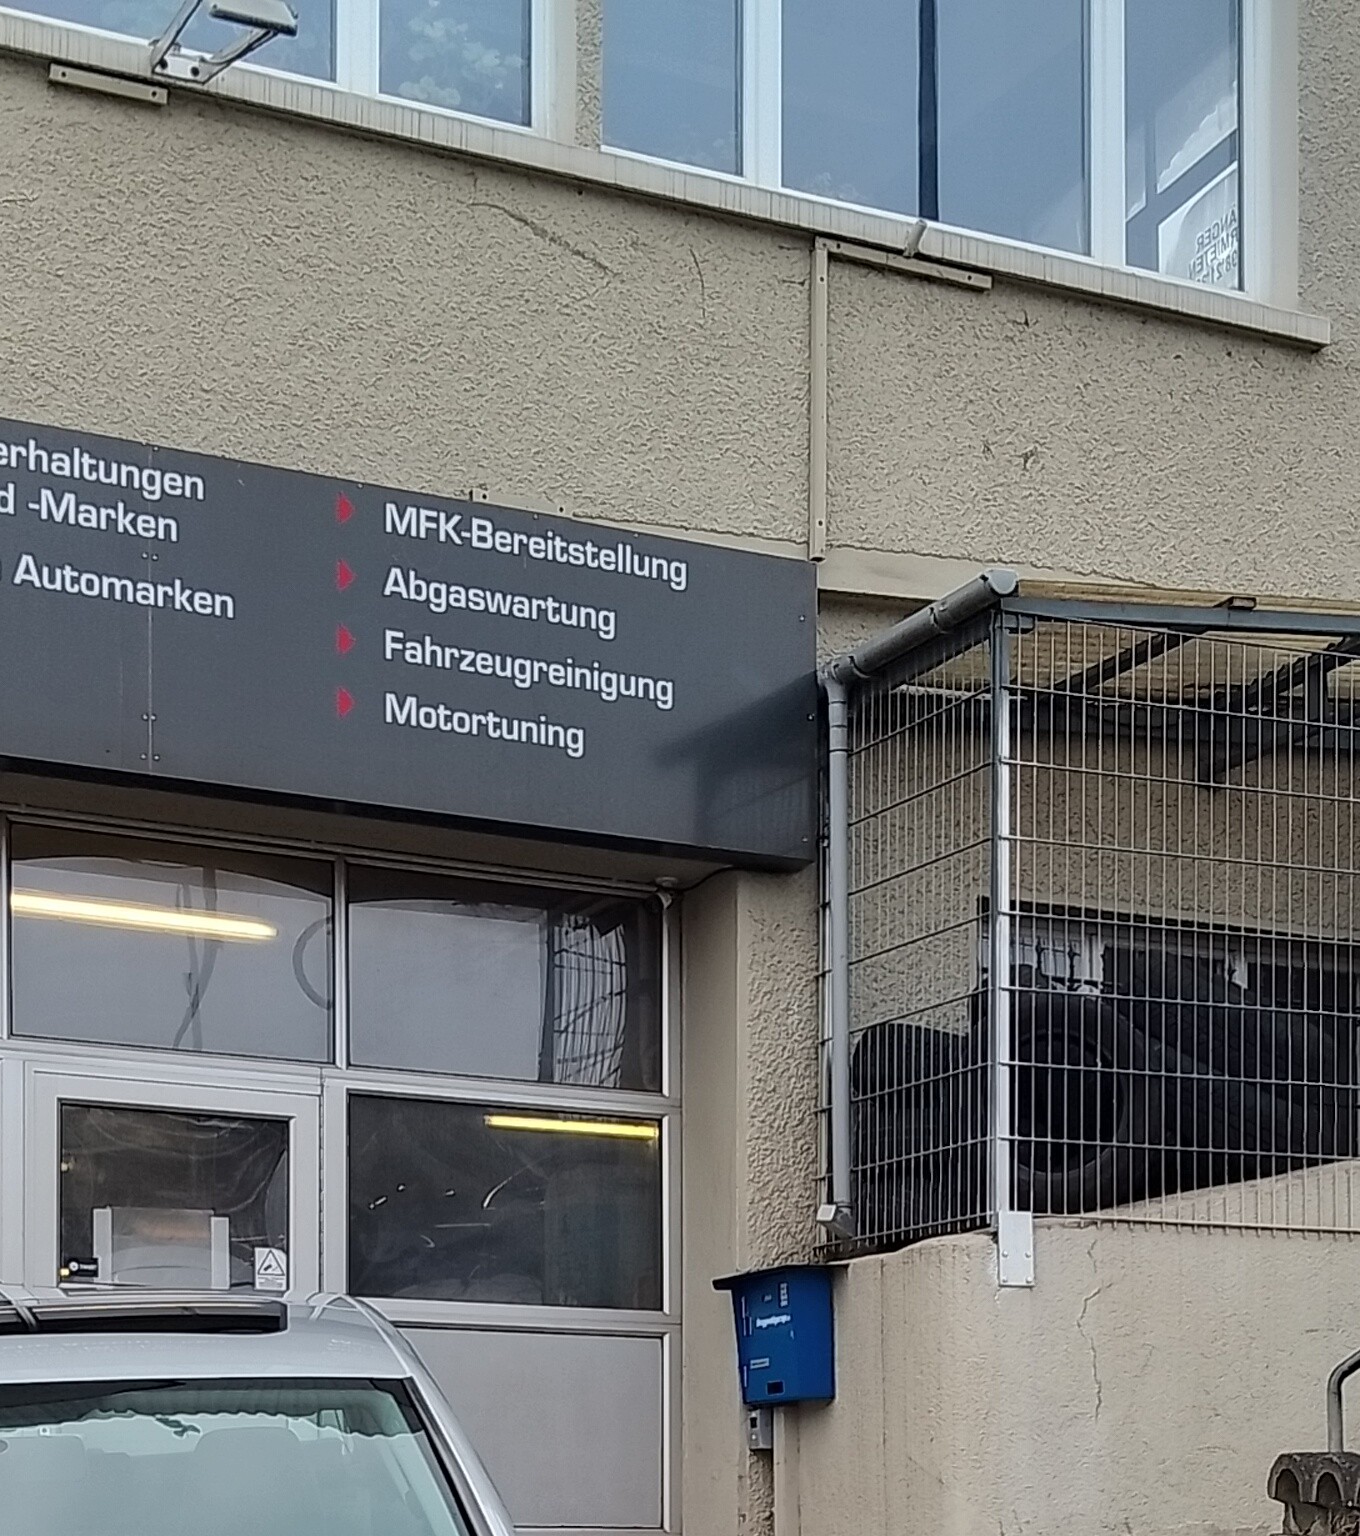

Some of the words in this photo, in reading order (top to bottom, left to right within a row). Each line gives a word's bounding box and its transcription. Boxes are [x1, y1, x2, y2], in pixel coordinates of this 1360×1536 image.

[27, 491, 179, 544] -Marken
[384, 502, 688, 591] MFK-Bereitstellung
[12, 553, 235, 619] Automarken
[383, 567, 617, 638] Abgaswartung
[384, 630, 674, 710] Fahrzeugreinigung
[384, 693, 586, 758] Motortuning
